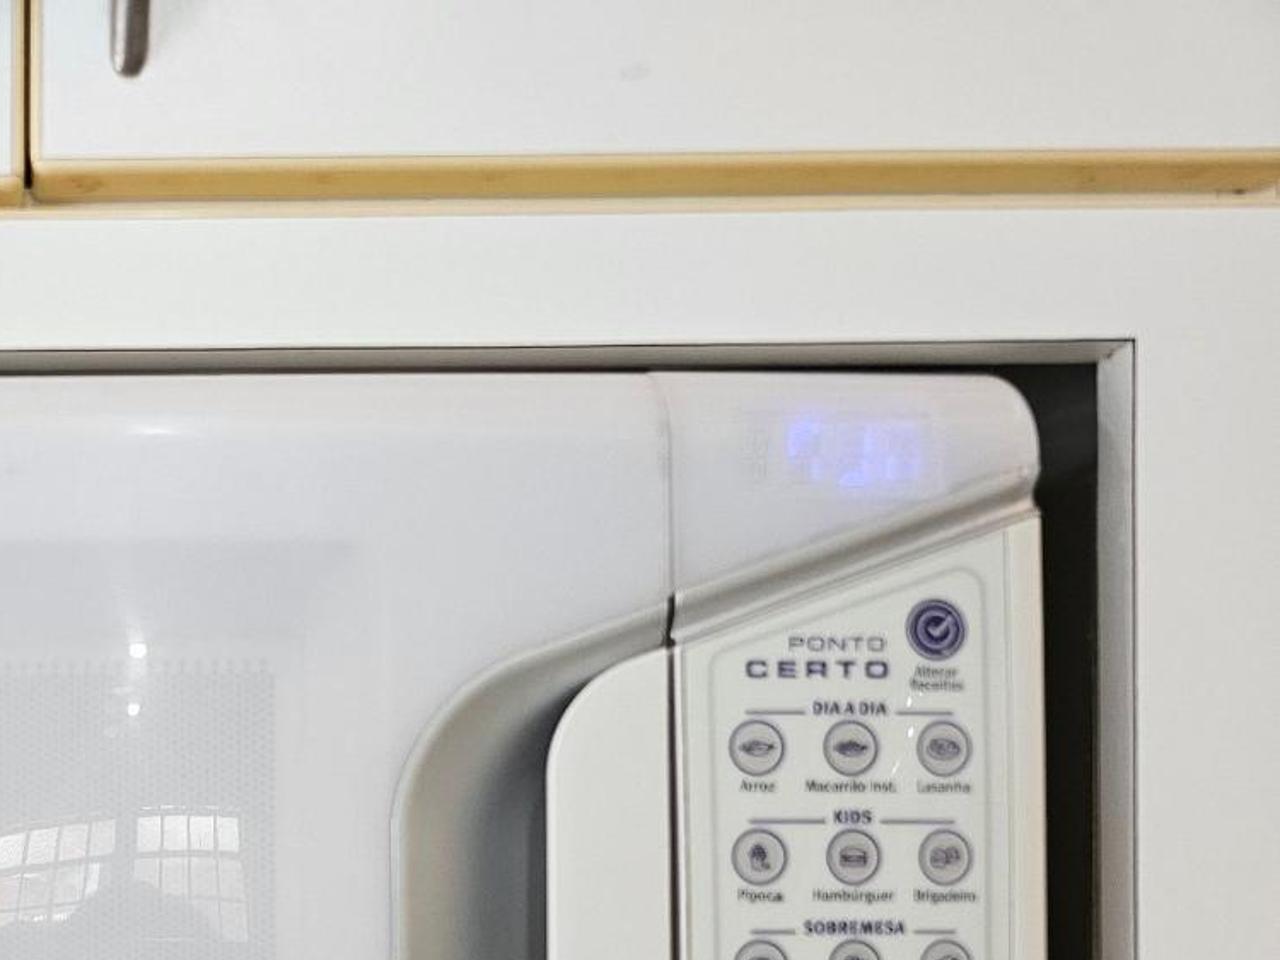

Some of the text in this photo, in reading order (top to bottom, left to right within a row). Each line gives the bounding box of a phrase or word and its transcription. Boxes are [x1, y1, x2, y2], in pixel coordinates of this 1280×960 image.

[787, 636, 888, 652] PONTO
[744, 660, 889, 679] CERTO
[812, 700, 888, 716] DIA A DIA
[740, 780, 775, 793] Arroz
[917, 780, 970, 793] Lasanha
[833, 810, 873, 825] KIDS
[737, 888, 783, 903] Pipoca
[803, 920, 905, 936] SOBREMESA
